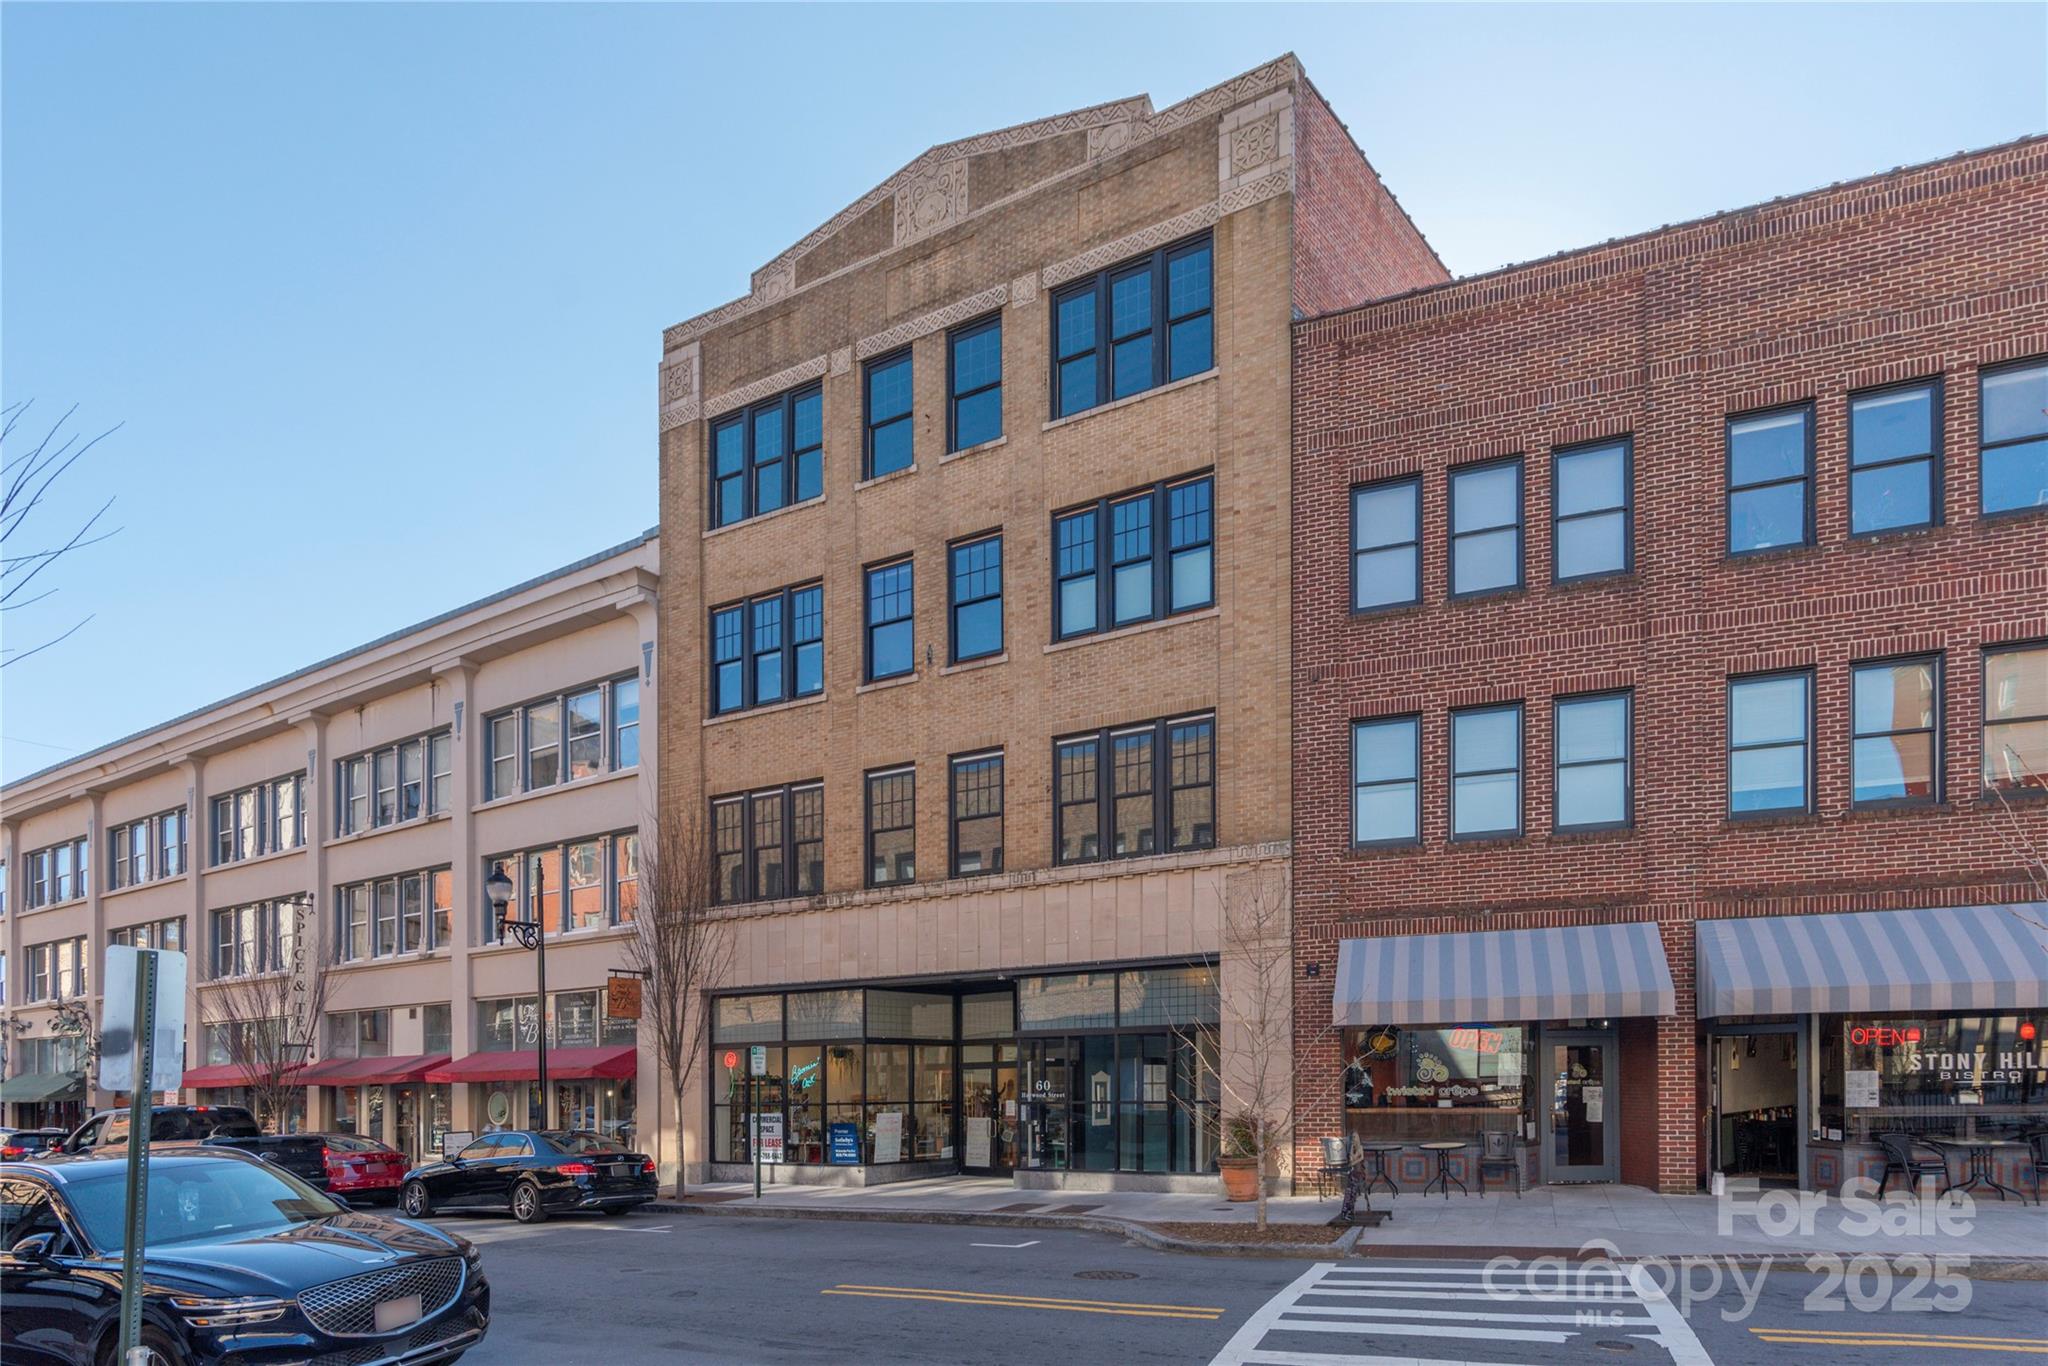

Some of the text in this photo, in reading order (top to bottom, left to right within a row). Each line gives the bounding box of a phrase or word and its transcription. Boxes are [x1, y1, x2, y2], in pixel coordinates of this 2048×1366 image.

[293, 909, 307, 1041] SPICE & TEA
[1448, 1028, 1504, 1056] OPEN
[1851, 1027, 1906, 1046] OPEN
[1910, 1052, 1987, 1070] STONY
[1940, 1071, 2022, 1080] BISTRO
[1035, 1080, 1051, 1091] 60
[1386, 1085, 1479, 1098] twisted crêpe
[752, 1115, 782, 1124] CMMERCIAL
[752, 1138, 782, 1148] FR LEASE
